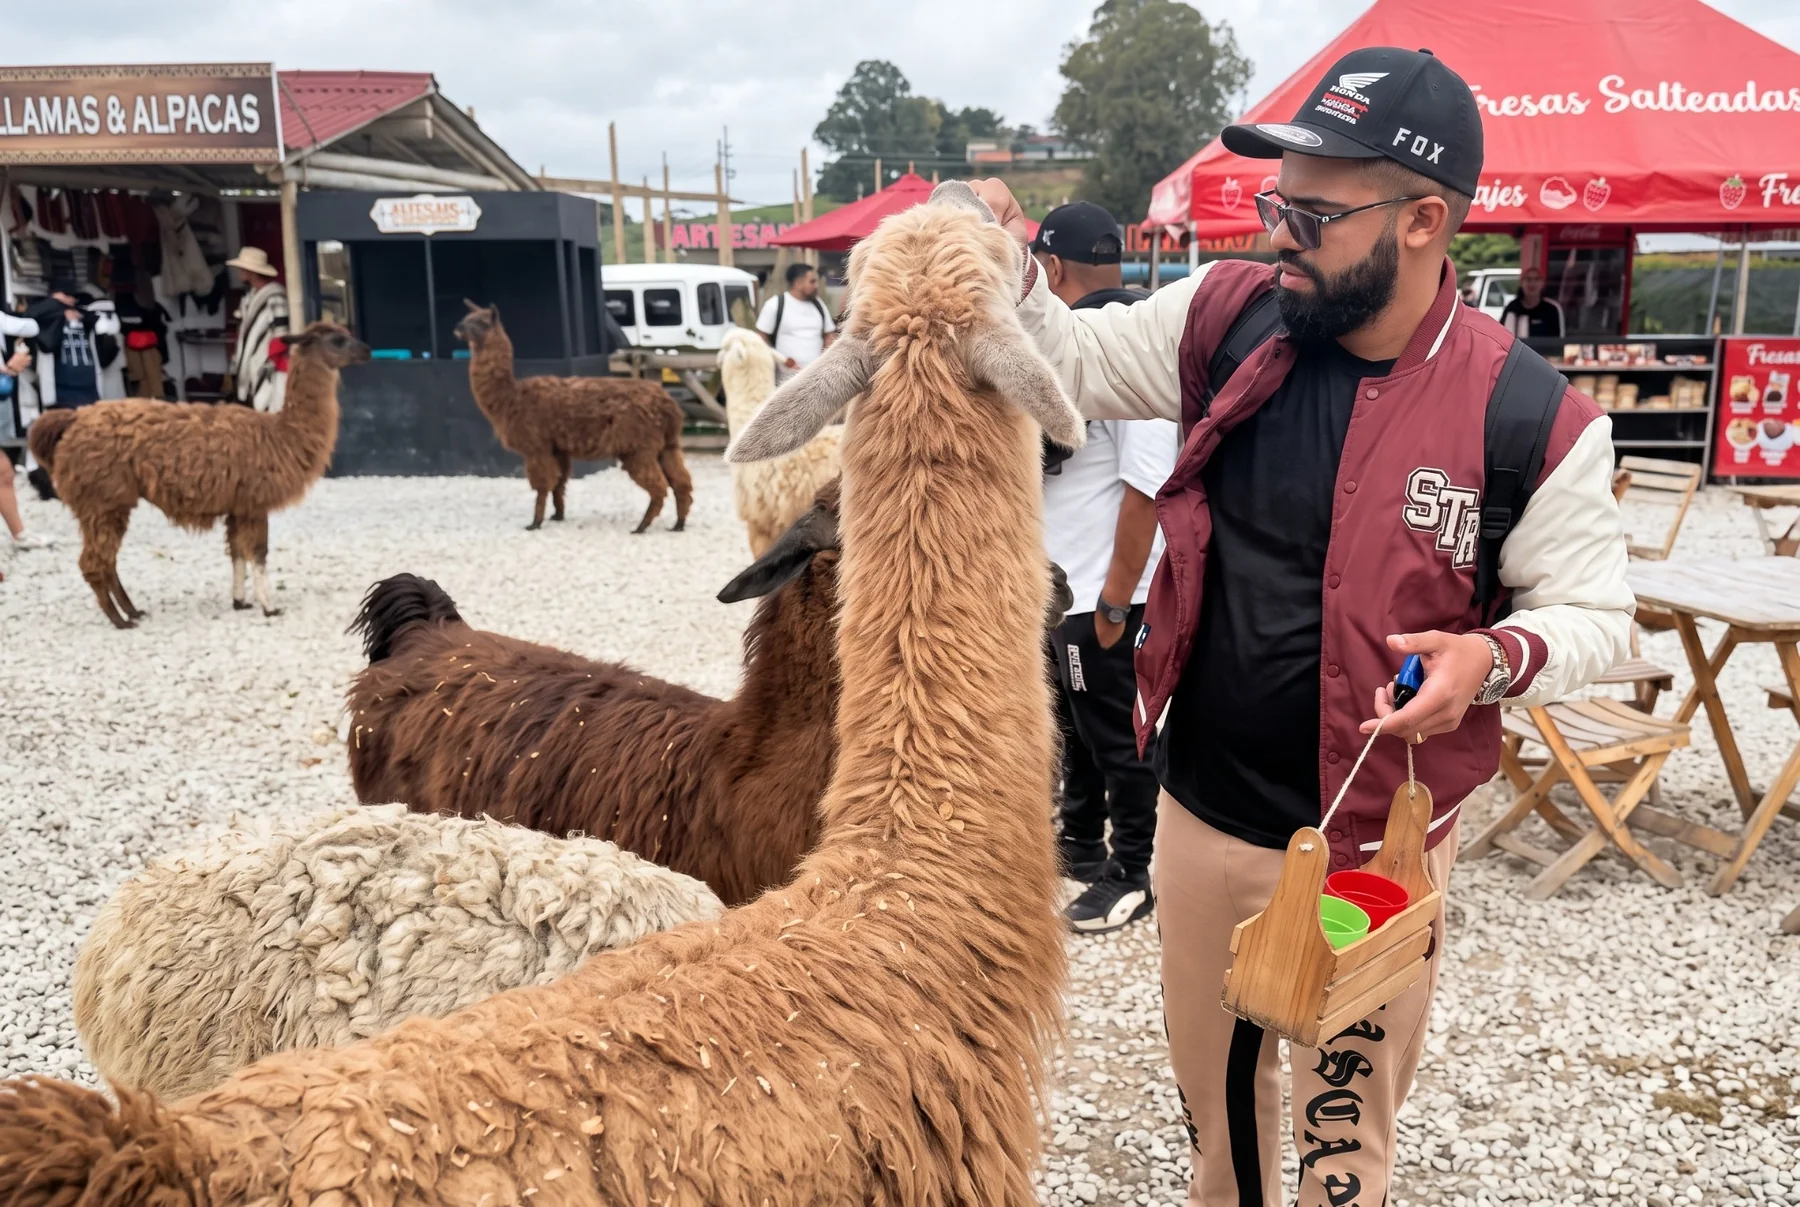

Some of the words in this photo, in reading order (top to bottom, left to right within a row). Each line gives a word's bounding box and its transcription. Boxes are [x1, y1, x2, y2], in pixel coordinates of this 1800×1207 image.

[1330, 85, 1371, 105] HONDA
[0, 95, 100, 135] LAMAS
[107, 94, 127, 134] &
[133, 93, 261, 135] ALPACAS
[1392, 127, 1445, 164] FOX
[1472, 179, 1528, 212] ajes
